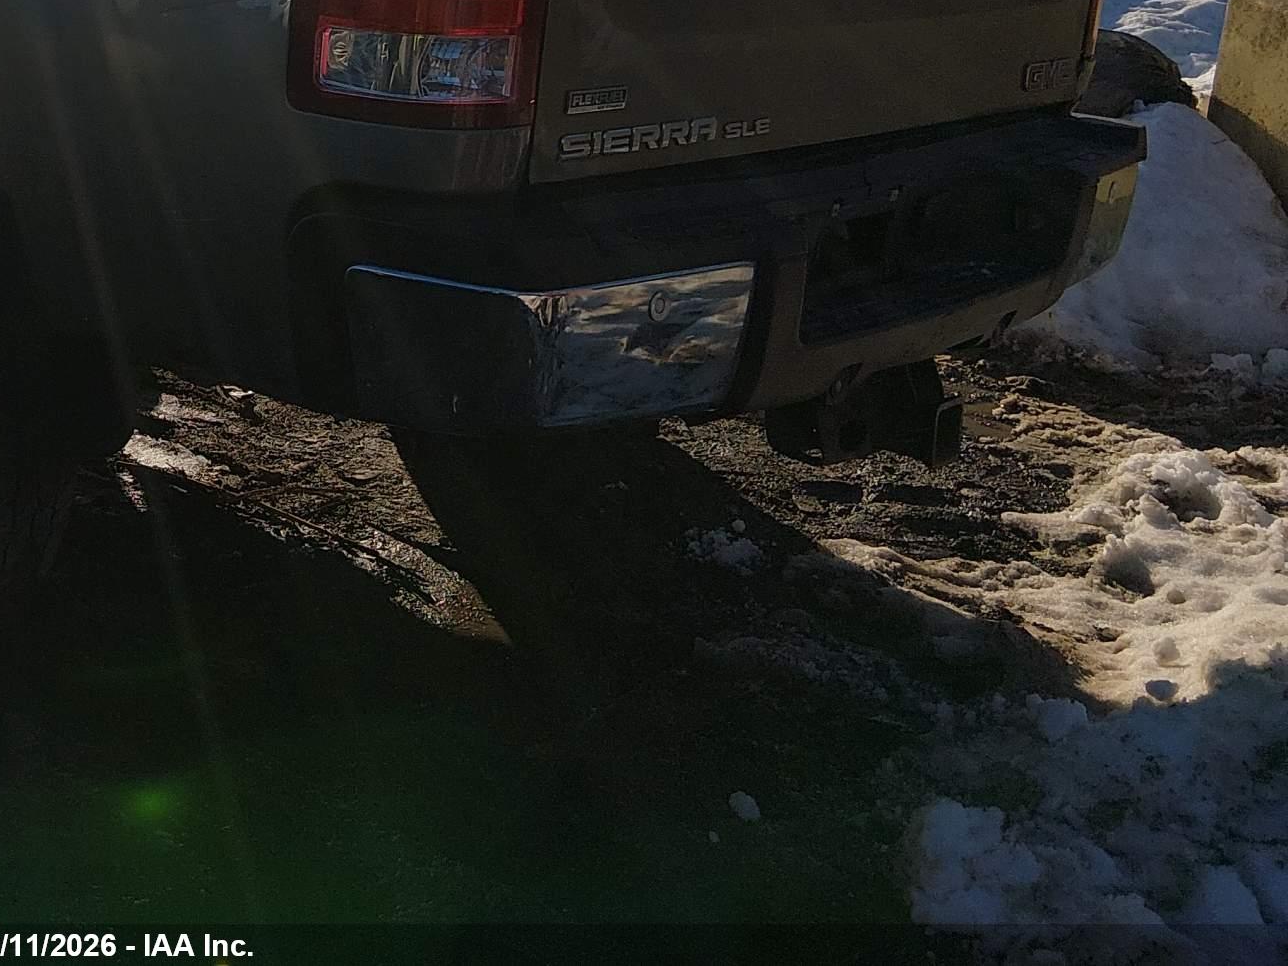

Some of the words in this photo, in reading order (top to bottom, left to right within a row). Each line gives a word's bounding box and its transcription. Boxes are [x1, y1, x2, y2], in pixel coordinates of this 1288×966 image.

[1023, 58, 1078, 91] GMC
[560, 116, 717, 158] SIERRA
[724, 117, 772, 140] SLE
